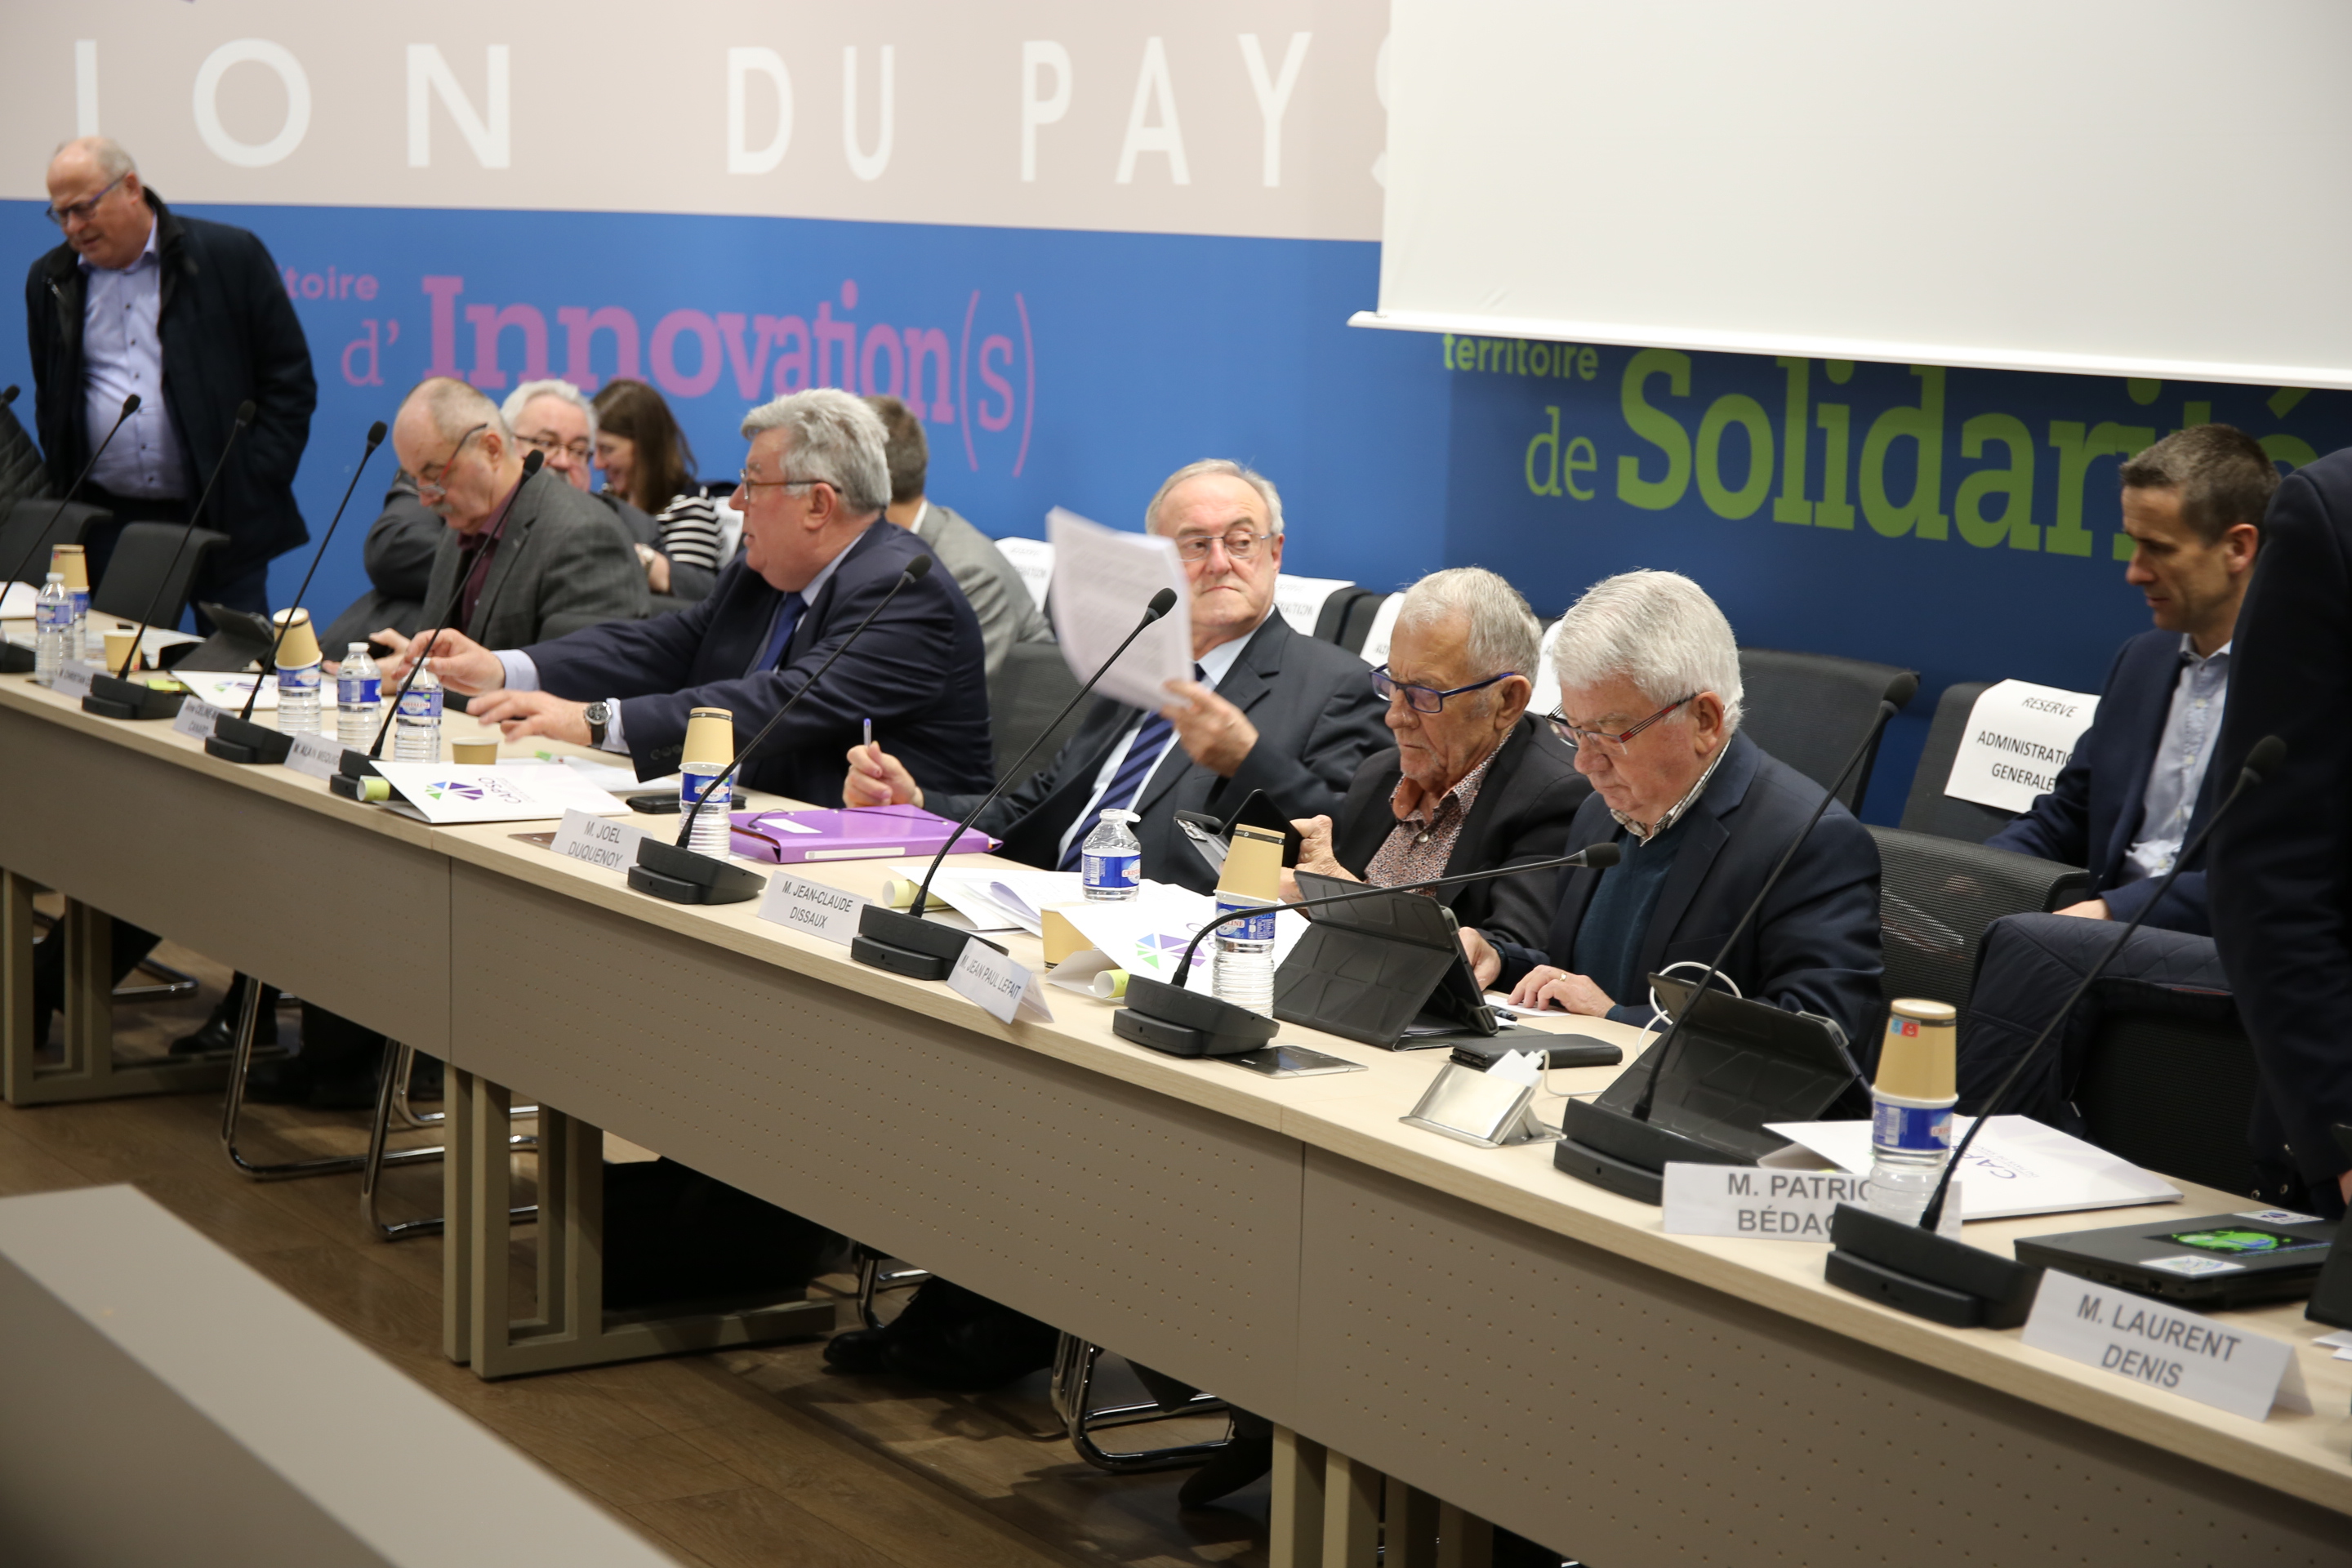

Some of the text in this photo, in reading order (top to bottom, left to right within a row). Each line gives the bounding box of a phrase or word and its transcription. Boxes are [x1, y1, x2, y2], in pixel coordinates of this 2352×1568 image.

[727, 46, 895, 181] DU
[276, 265, 380, 301] toire
[1442, 333, 1599, 381] territoire
[421, 275, 1035, 478] Innovation(s)
[1525, 405, 1597, 501] de
[2021, 697, 2079, 719] RESERVE
[1991, 763, 2056, 792] GENERALE
[584, 821, 621, 844] M. JOEL
[568, 841, 623, 868] DUQUENOY
[782, 880, 853, 913] M. JEAN-CLAUDE
[790, 906, 828, 929] DISSAUX
[960, 954, 1022, 1000] M. JEAN PAUL LEFAIT
[1727, 1173, 1759, 1196] M.
[2077, 1294, 2242, 1362] M. LAURENT
[2101, 1343, 2184, 1388] DENIS
